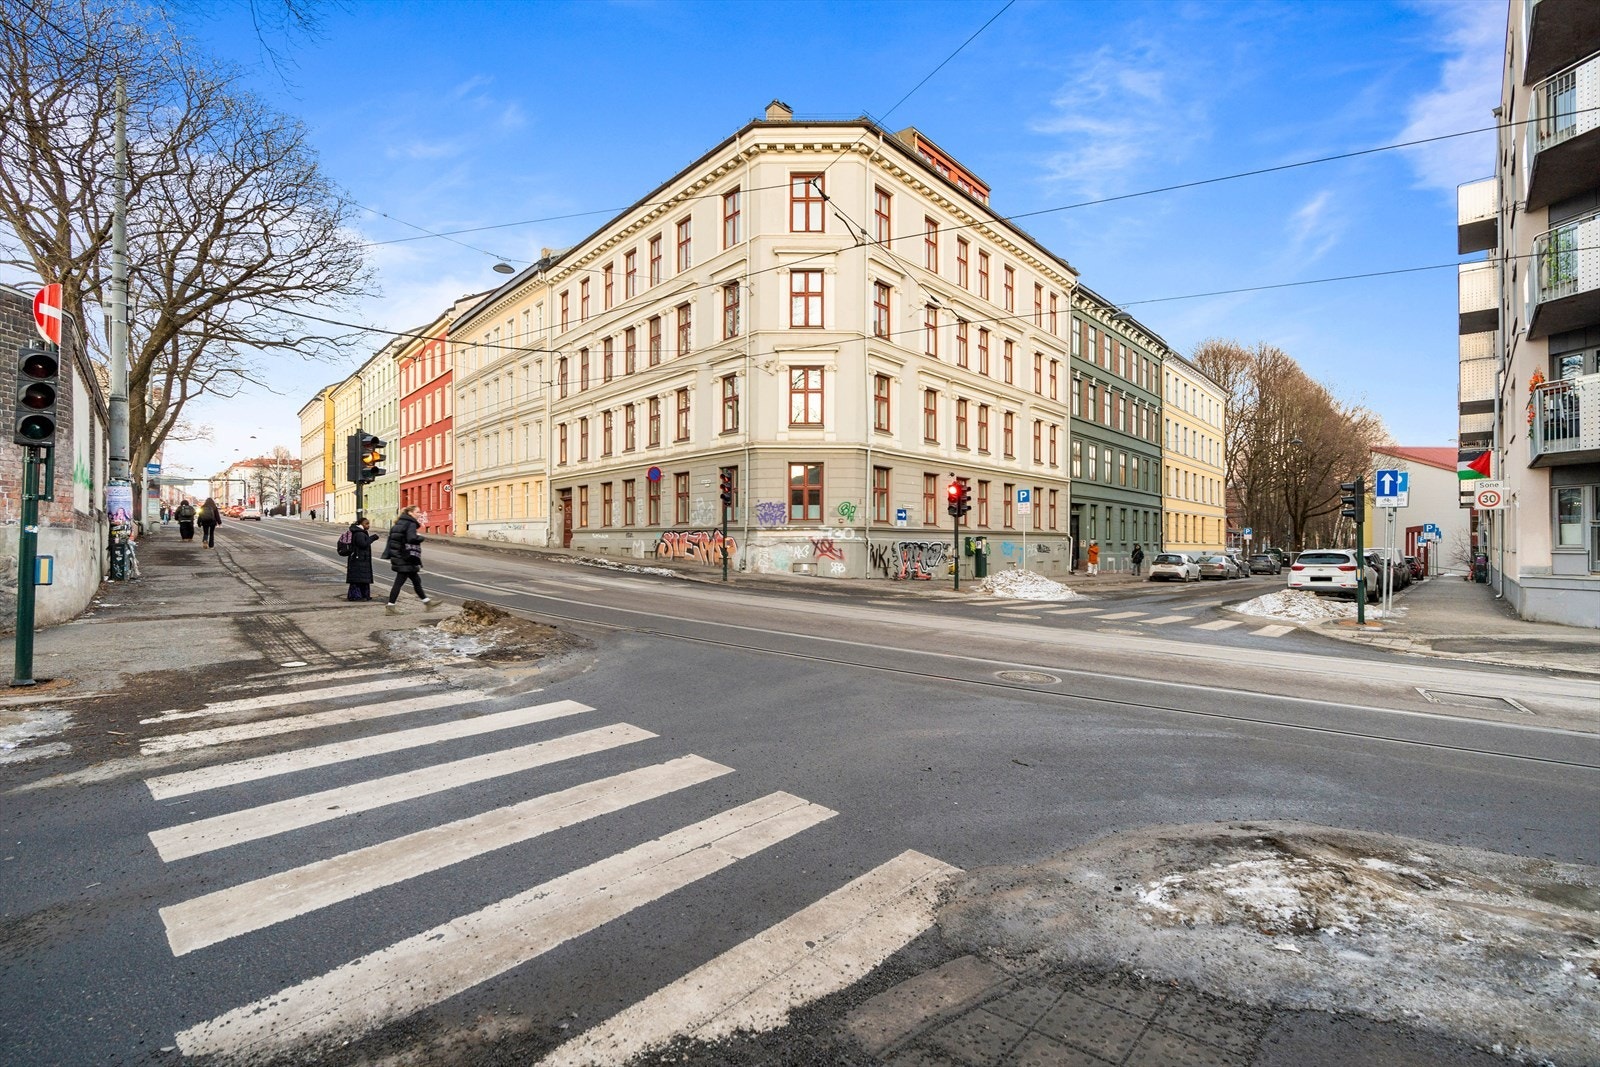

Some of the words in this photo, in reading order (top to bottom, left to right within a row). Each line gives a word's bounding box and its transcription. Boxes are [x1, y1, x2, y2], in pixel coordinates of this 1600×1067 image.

[1020, 491, 1027, 501] P
[1482, 494, 1497, 503] 30
[1426, 524, 1433, 532] P
